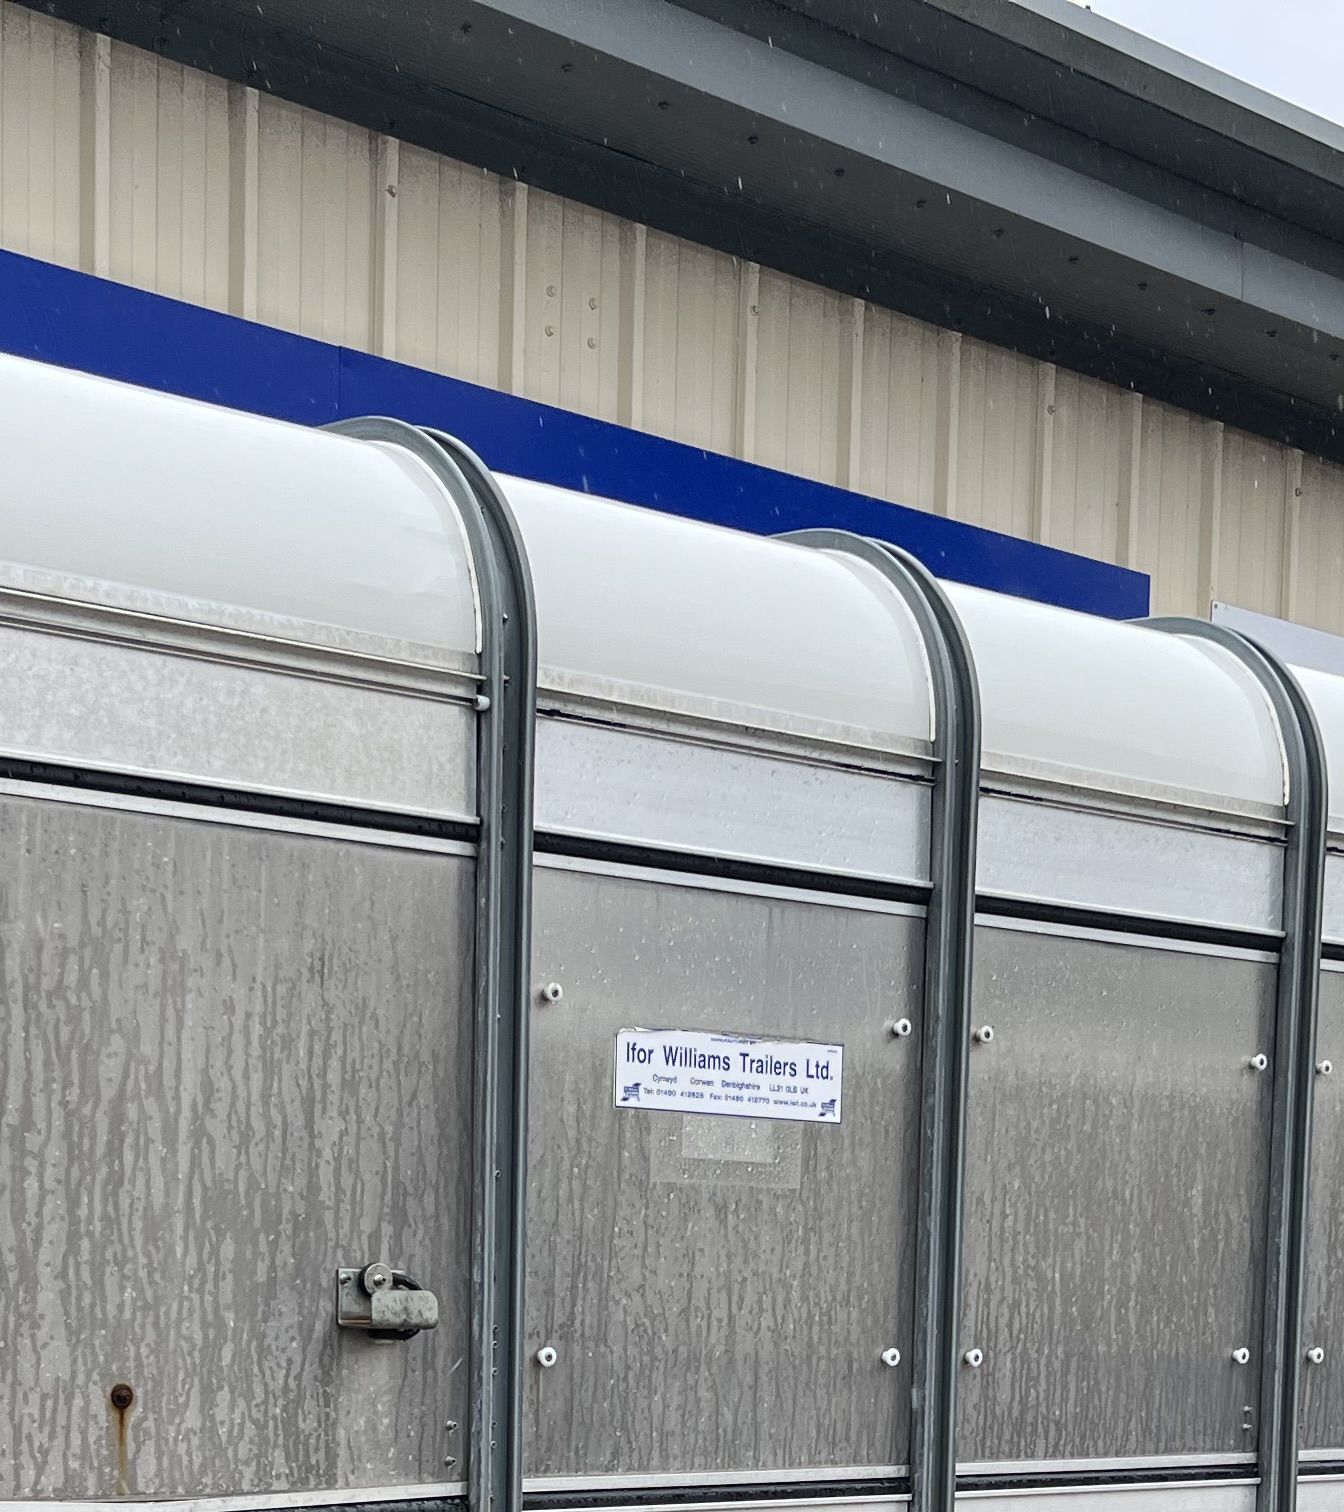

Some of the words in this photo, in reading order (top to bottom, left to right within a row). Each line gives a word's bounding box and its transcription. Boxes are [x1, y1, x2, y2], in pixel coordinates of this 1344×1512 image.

[626, 1041, 654, 1065] Ifor
[662, 1045, 731, 1072] Williams
[739, 1052, 797, 1077] Trailers
[806, 1058, 834, 1080] Ltd.
